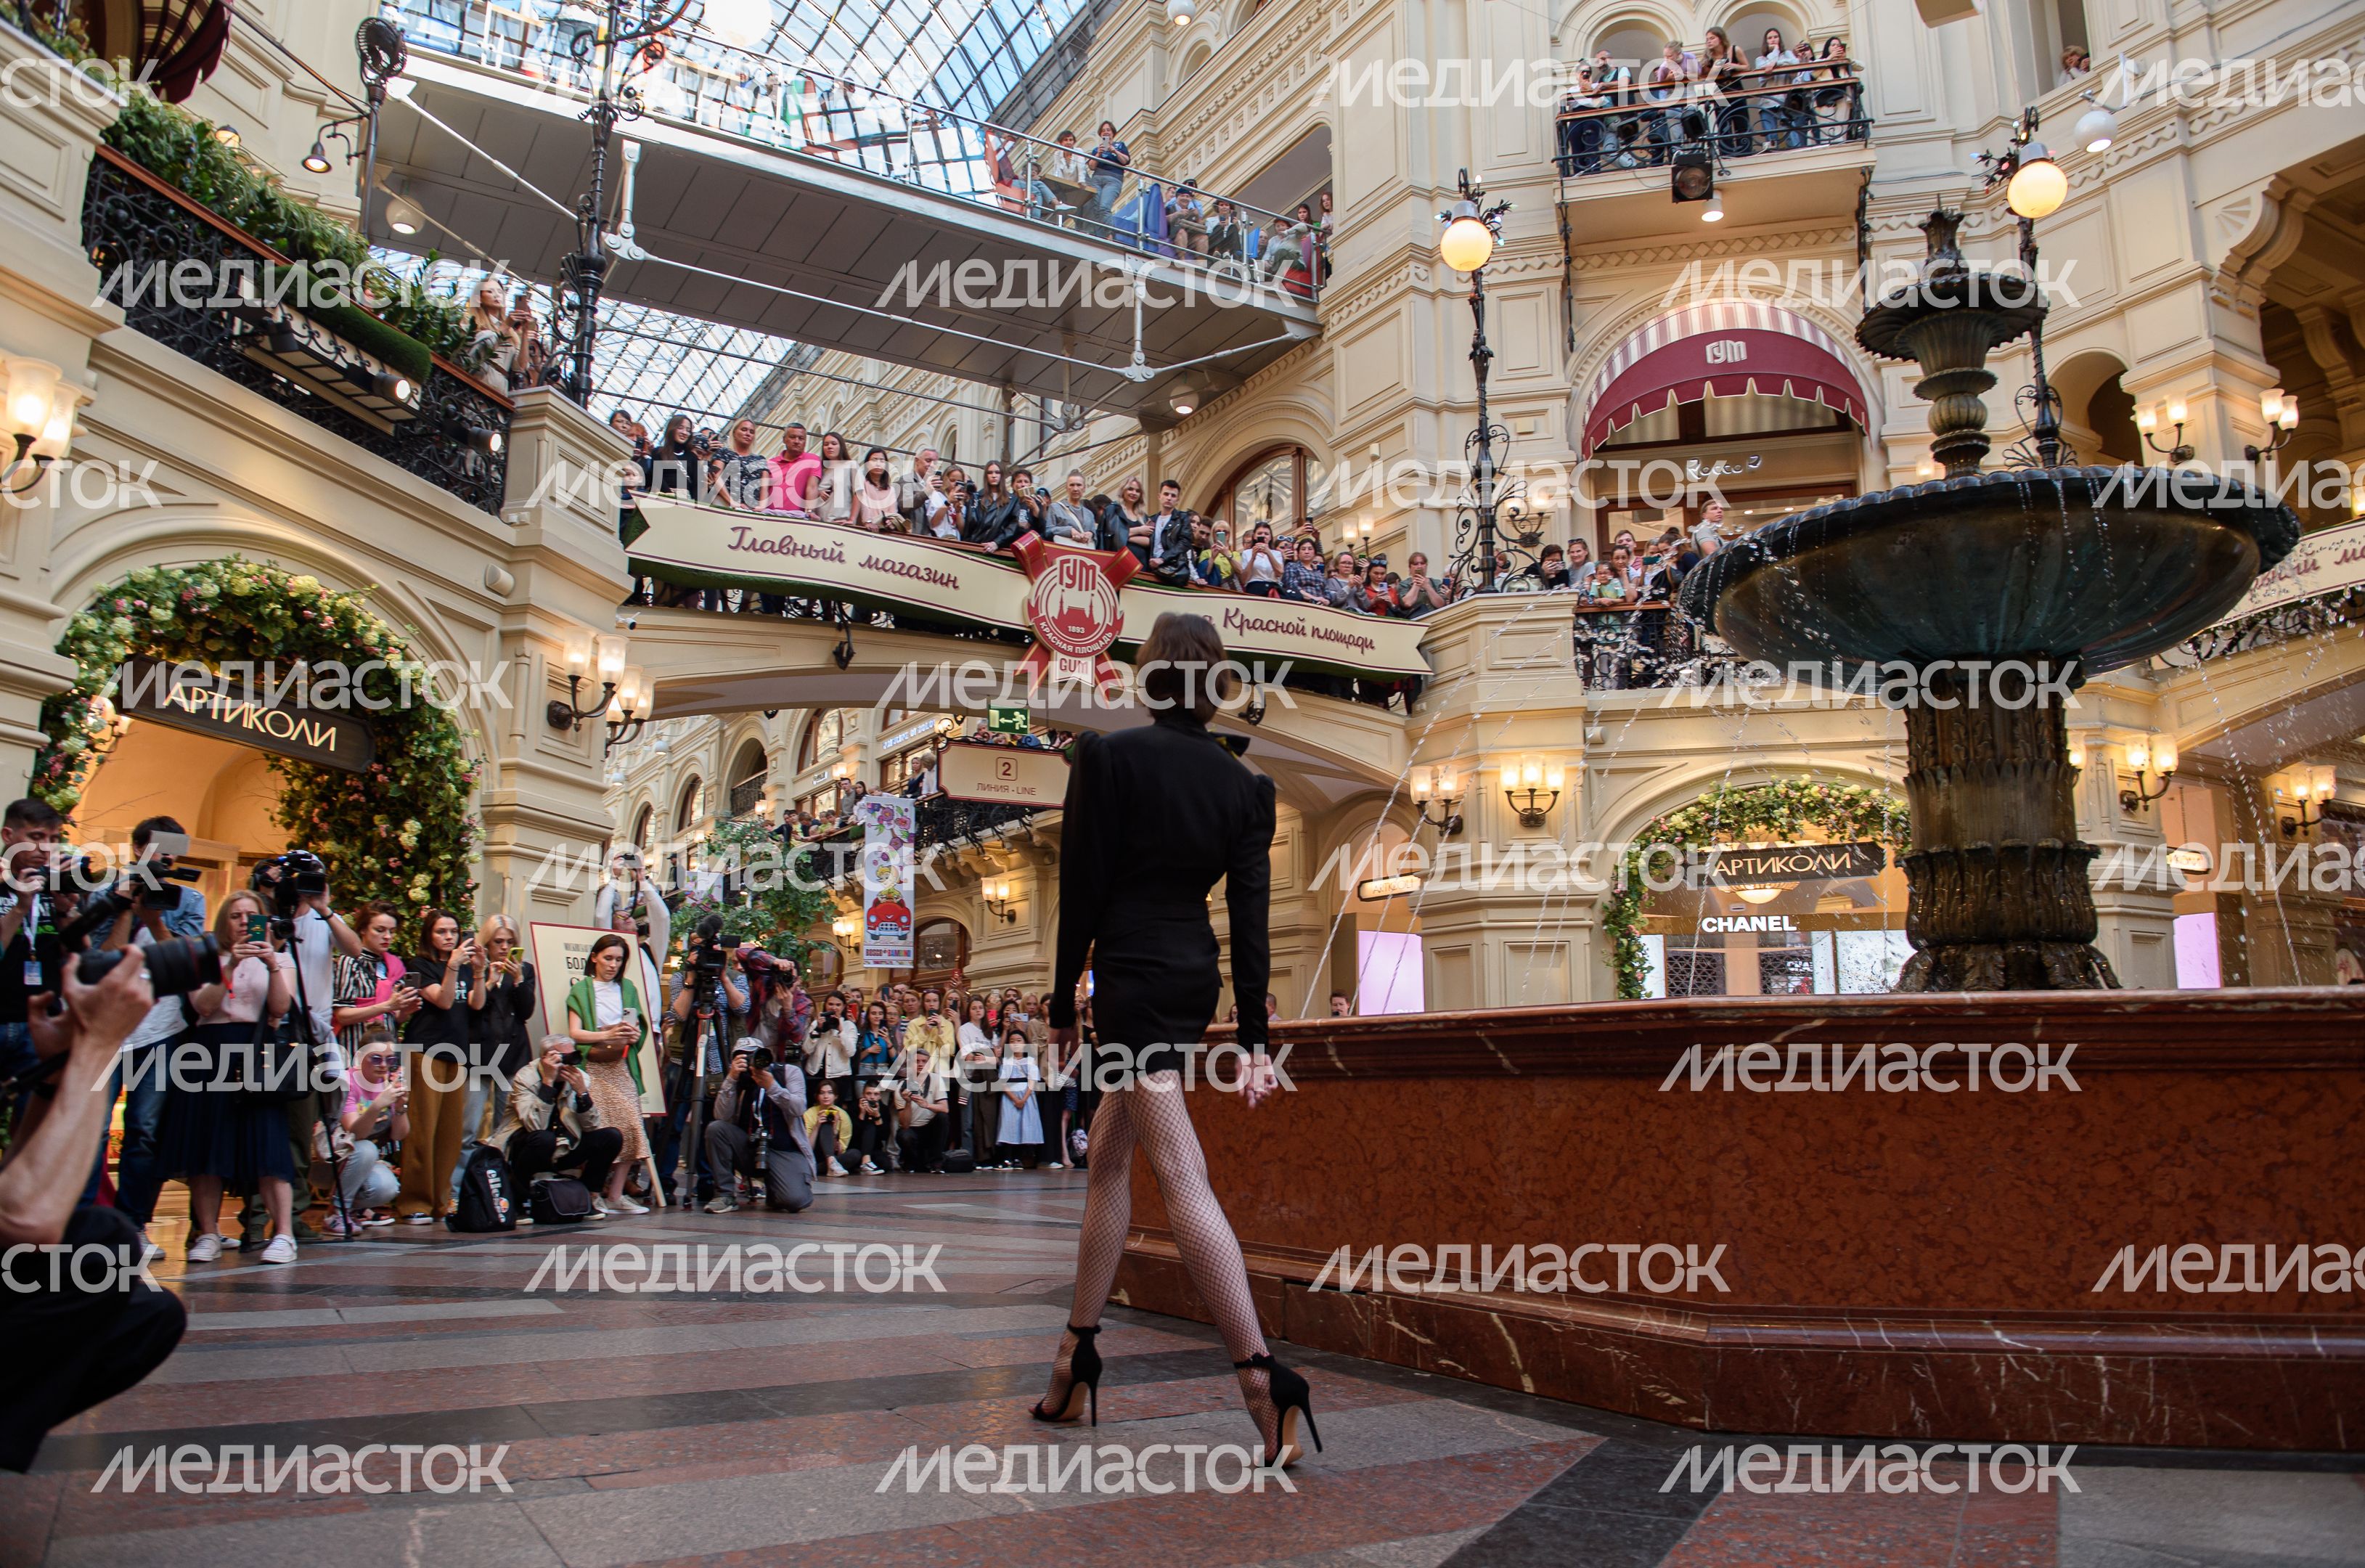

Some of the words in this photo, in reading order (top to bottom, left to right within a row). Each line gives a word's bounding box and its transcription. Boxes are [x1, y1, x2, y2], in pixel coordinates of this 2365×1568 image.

[727, 526, 846, 564] Главный
[859, 554, 960, 589] магазин
[1039, 621, 1074, 652] КРАСНАЯ
[1074, 632, 1113, 654] ПЛОЩАДЬ
[1067, 625, 1085, 634] 1893
[1223, 607, 1307, 637] Красной
[1311, 624, 1376, 655] площади
[1059, 657, 1088, 674] GUM
[163, 682, 337, 751] АРТИКОЛИ
[1002, 762, 1011, 776] 2
[976, 783, 1009, 793] ЛИНИЯ
[1017, 786, 1037, 796] LINE
[1712, 852, 1851, 877] АРТИКОЛИ
[1702, 915, 1797, 933] CHANEL
